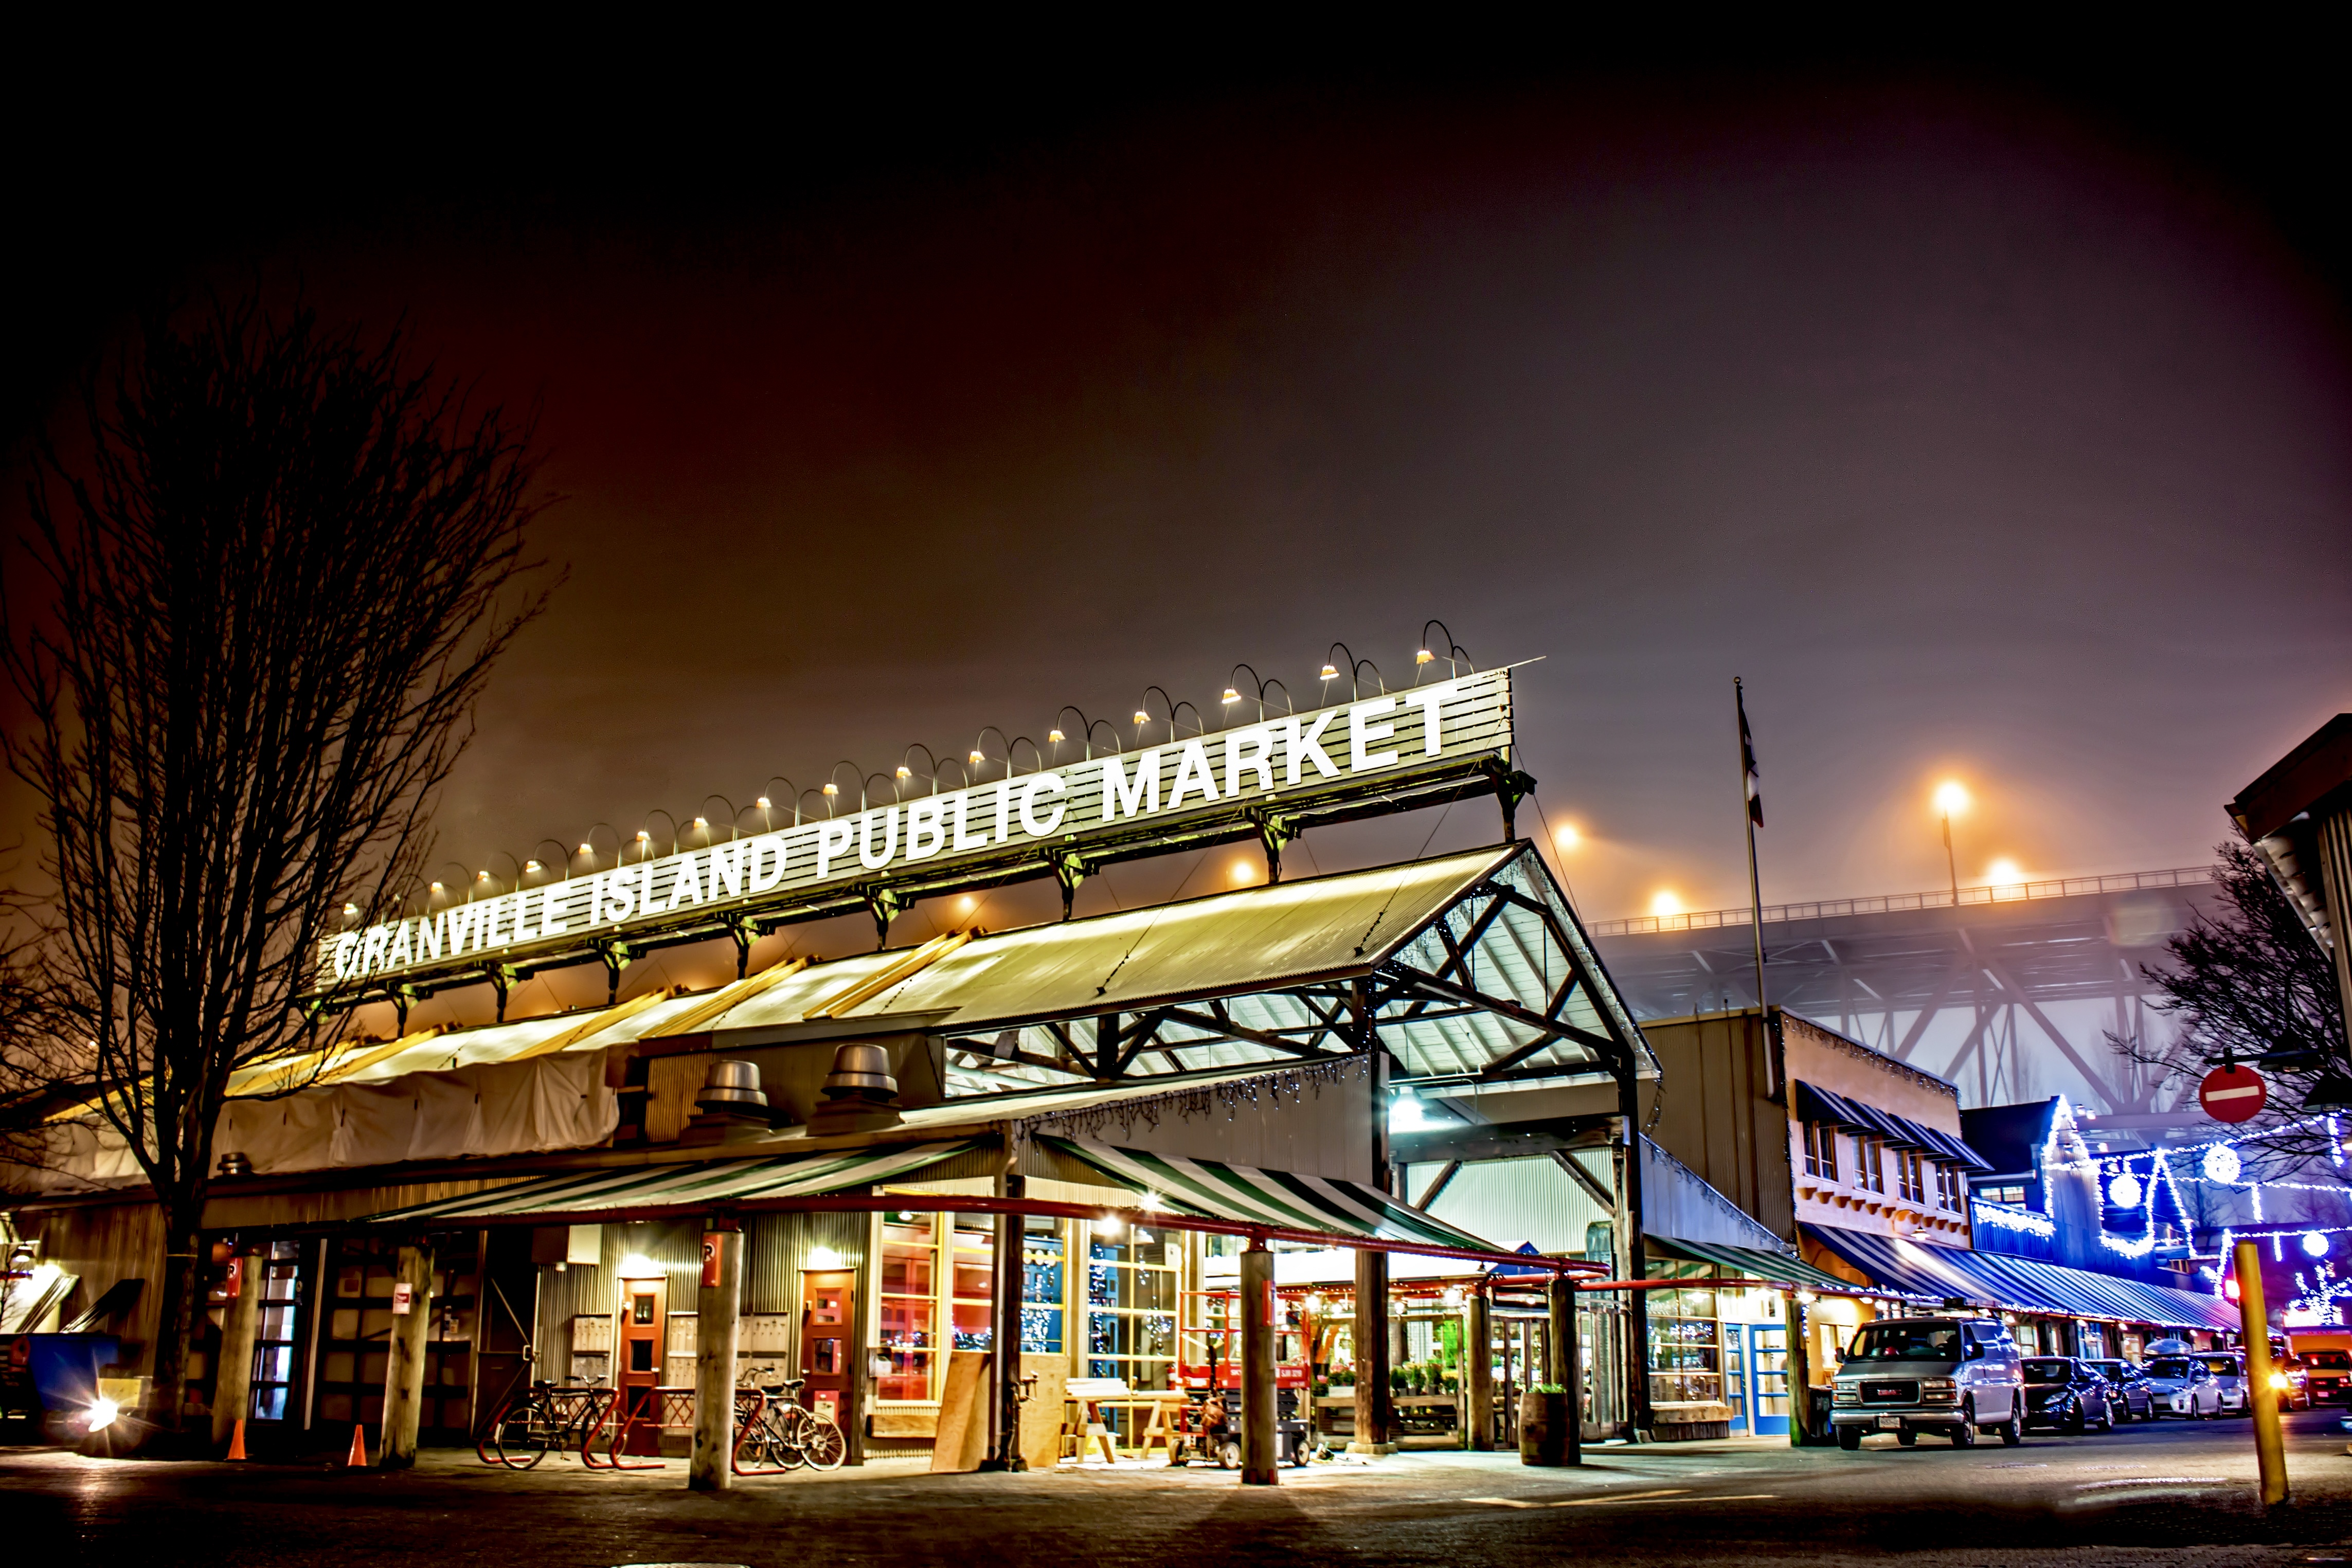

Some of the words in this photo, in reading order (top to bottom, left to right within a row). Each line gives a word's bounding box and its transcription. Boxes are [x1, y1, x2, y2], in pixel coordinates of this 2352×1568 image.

[334, 881, 571, 979] GRANVILLE
[590, 835, 787, 926] ISLAND
[817, 773, 1066, 878] PUBLIC
[1102, 682, 1459, 822] MARKET
